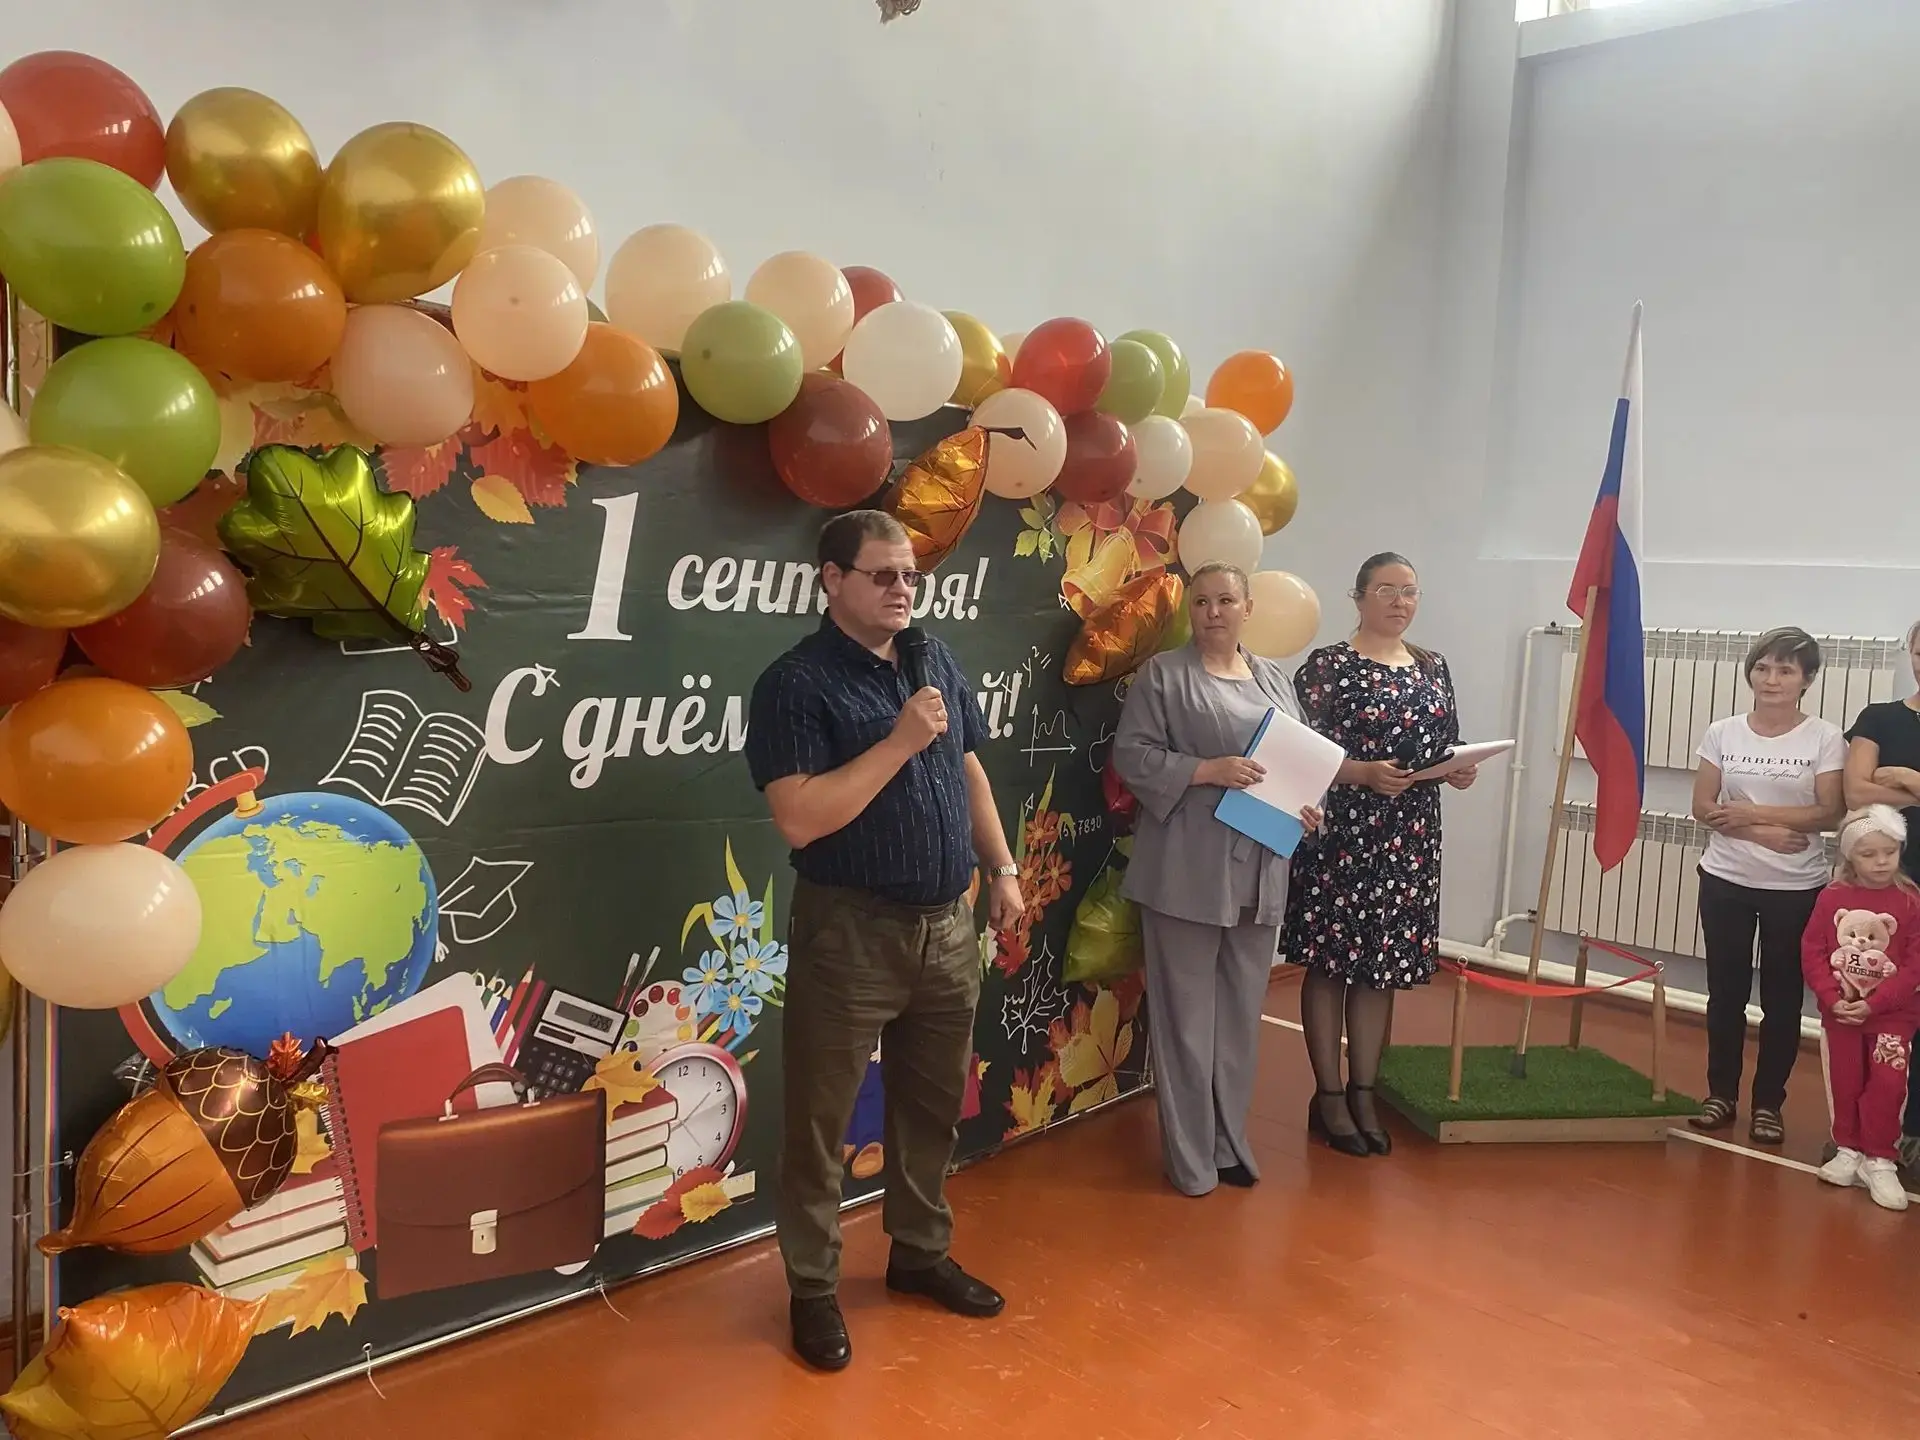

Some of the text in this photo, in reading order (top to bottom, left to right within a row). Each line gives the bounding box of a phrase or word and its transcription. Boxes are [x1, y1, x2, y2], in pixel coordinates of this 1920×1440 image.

[566, 491, 639, 641] 1
[484, 667, 544, 765] С
[1721, 754, 1813, 767] BURBERRY
[1848, 953, 1861, 967] Я
[677, 1065, 689, 1078] 12
[702, 1066, 706, 1077] 1
[715, 1081, 722, 1092] 2
[720, 1103, 727, 1115] 3
[715, 1131, 721, 1142] 4
[697, 1154, 703, 1166] 5
[676, 1165, 683, 1176] 6
